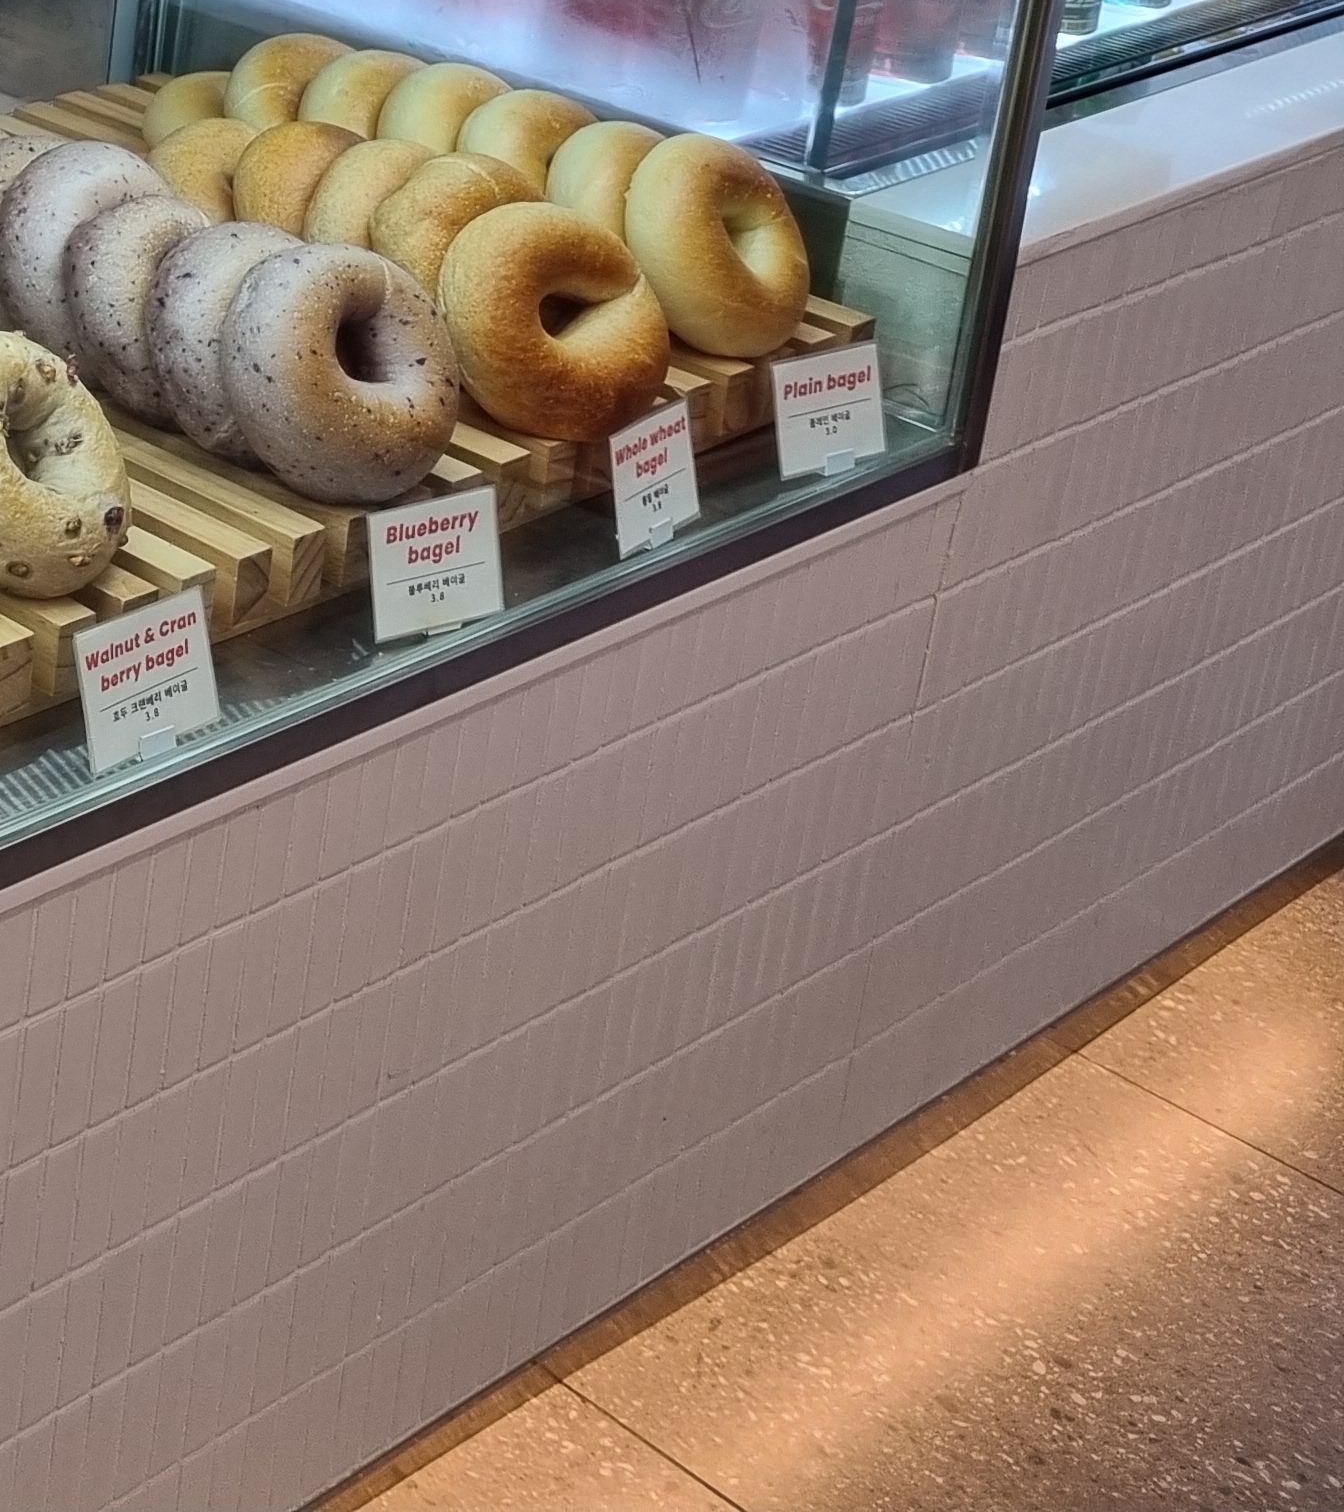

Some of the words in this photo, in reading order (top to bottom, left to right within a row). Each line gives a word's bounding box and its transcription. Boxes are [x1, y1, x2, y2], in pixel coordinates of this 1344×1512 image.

[784, 378, 822, 400] Plain
[827, 365, 871, 390] bagel
[615, 437, 648, 466] Whole
[650, 416, 686, 446] wheat
[636, 447, 667, 478] bagel
[386, 511, 478, 544] Blueberry
[408, 535, 460, 564] bagel
[85, 633, 140, 670] Walnut
[144, 627, 155, 644] &
[159, 612, 196, 636] Cran
[101, 662, 142, 691] berry
[146, 638, 189, 671] bagel
[164, 680, 188, 697] 베이글
[146, 708, 159, 721] 3.8
